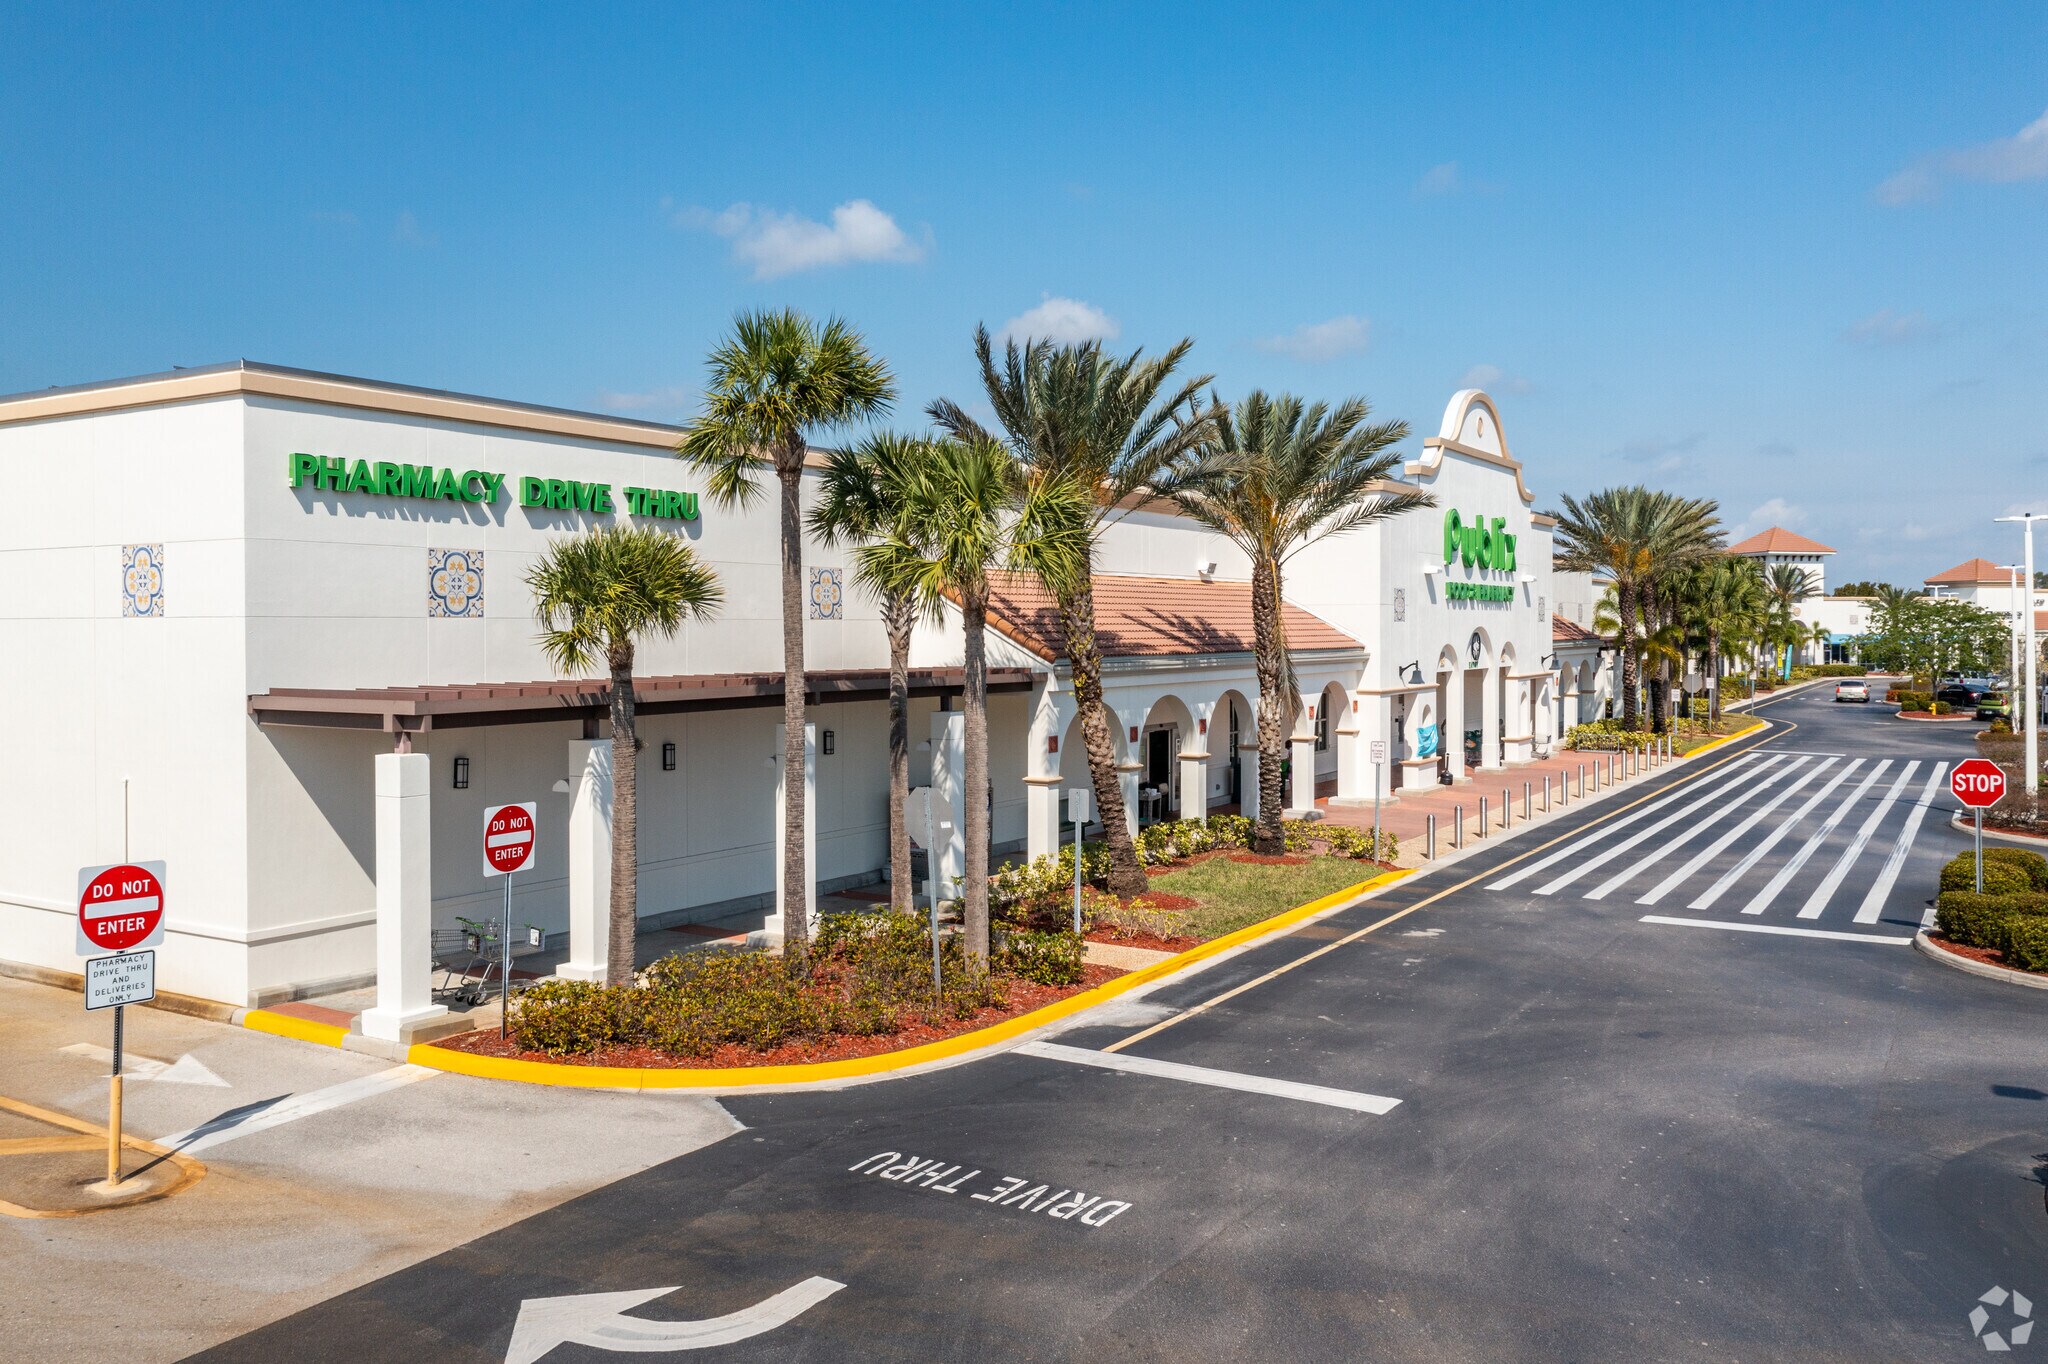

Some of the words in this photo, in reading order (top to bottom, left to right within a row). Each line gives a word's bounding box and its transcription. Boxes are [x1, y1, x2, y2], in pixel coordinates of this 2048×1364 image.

[288, 452, 505, 503] PHARMACY
[519, 476, 612, 513] DRIVE
[623, 486, 699, 521] THRU
[1443, 508, 1517, 572] Publix
[1954, 773, 2003, 793] STOP
[492, 820, 505, 832] DO
[510, 816, 528, 829] NOT
[495, 846, 524, 861] ENTER
[92, 884, 114, 899] DO
[122, 879, 150, 895] NOT
[97, 917, 146, 936] ENTER
[96, 954, 145, 968] PHARMACY
[93, 967, 119, 978] DRIVE
[126, 963, 148, 973] THRU
[112, 975, 130, 984] AND
[95, 981, 146, 997] DELIVERIES
[109, 994, 131, 1003] ONLY
[848, 1151, 982, 1193] THRU
[970, 1175, 1133, 1227] DRIVE
